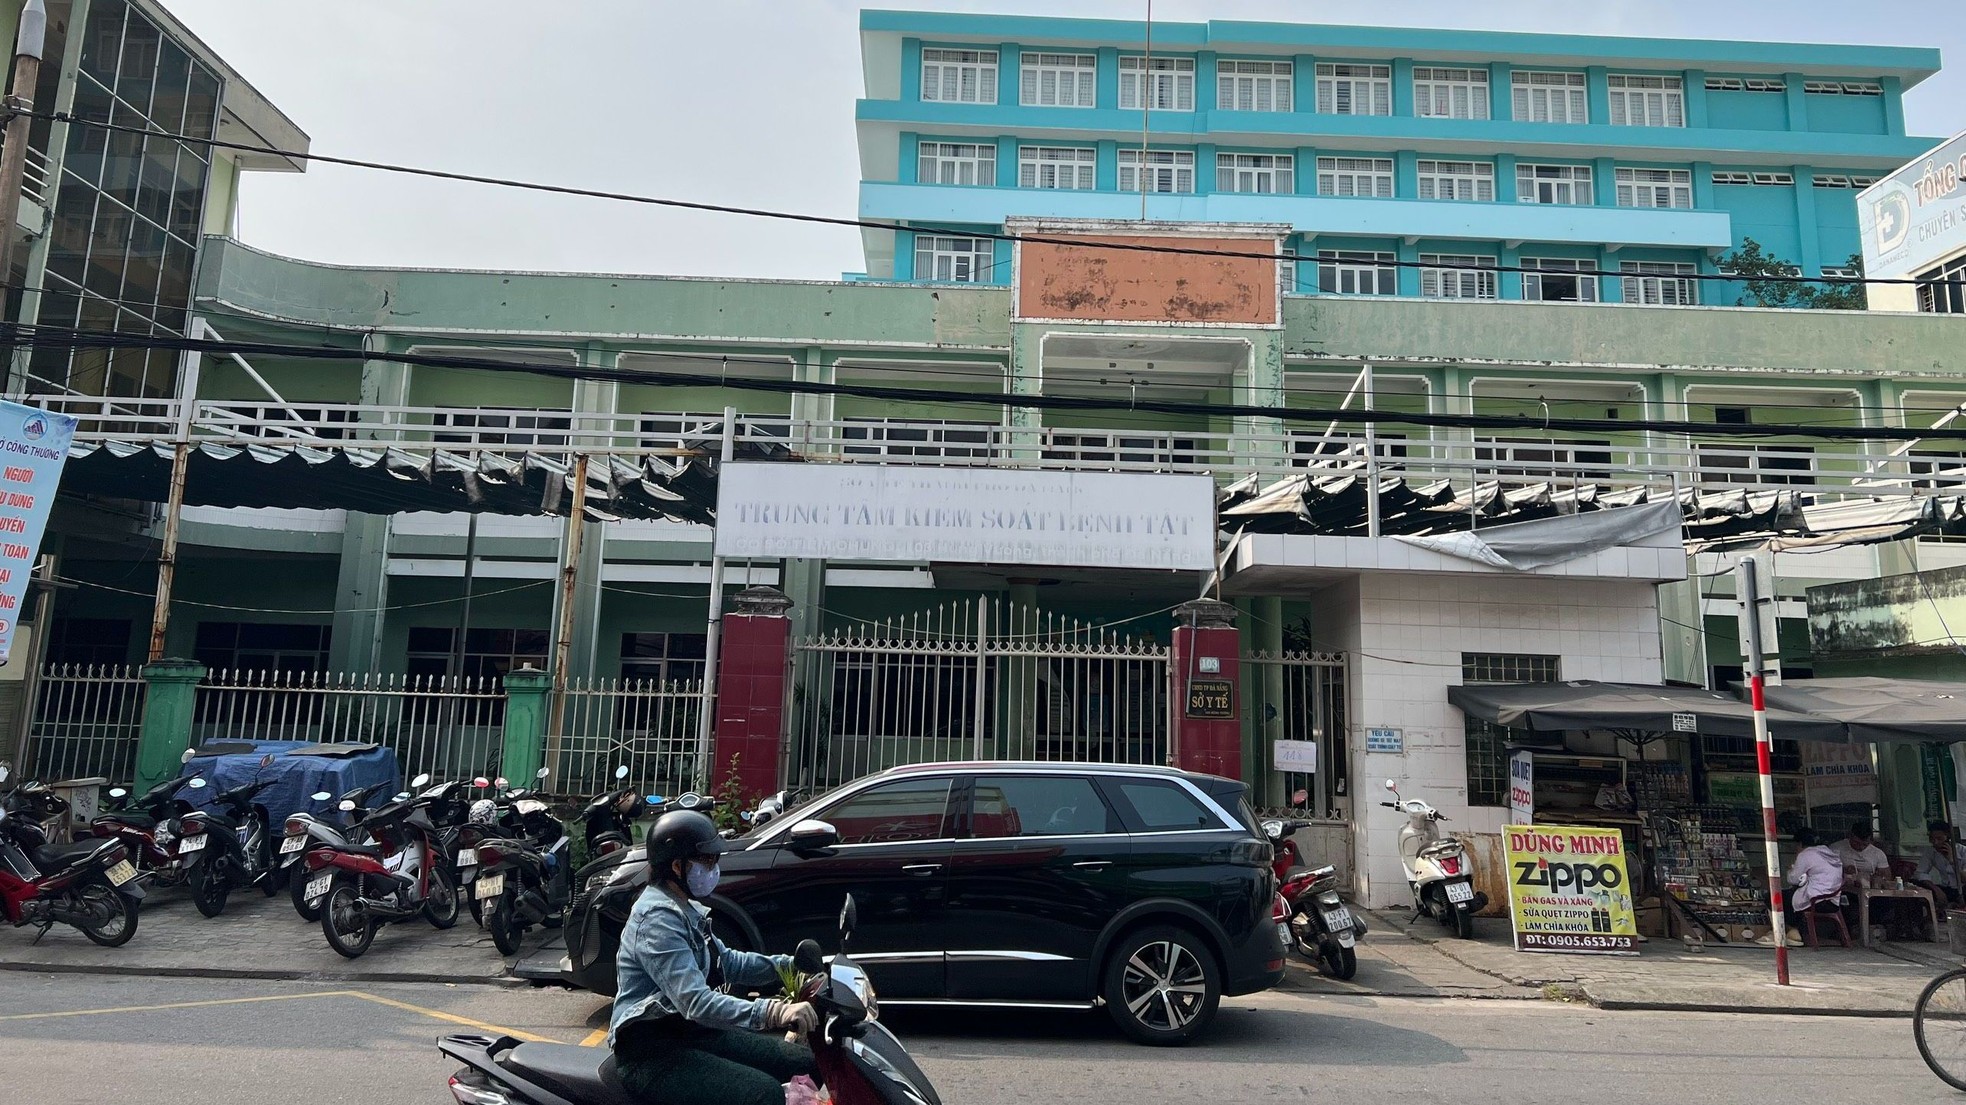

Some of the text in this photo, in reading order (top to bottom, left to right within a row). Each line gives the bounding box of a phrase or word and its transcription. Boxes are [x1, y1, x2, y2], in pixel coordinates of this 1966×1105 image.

[1913, 159, 1957, 208] TỔNG
[1918, 209, 1956, 242] CHUYÊN
[6, 440, 29, 454] CÔNG
[30, 446, 60, 460] THƯƠNG
[3, 466, 34, 483] NGƯỜI
[735, 503, 829, 524] TRUNG
[838, 499, 895, 526] TÂM
[981, 502, 1051, 530] SOÁT
[0, 515, 25, 533] UYẾN
[1201, 658, 1218, 669] 103
[1192, 692, 1228, 708] SỞ Y TẾ
[1510, 828, 1620, 855] DŨNG MINH
[1540, 897, 1557, 905] GAS
[1558, 895, 1569, 905] VÀ
[1524, 906, 1589, 920] SỬA QUẸT ZIPPO
[1525, 920, 1589, 932] LÀM CHÌA KHÓA
[1526, 934, 1632, 948] ĐT: 0905.653.753
